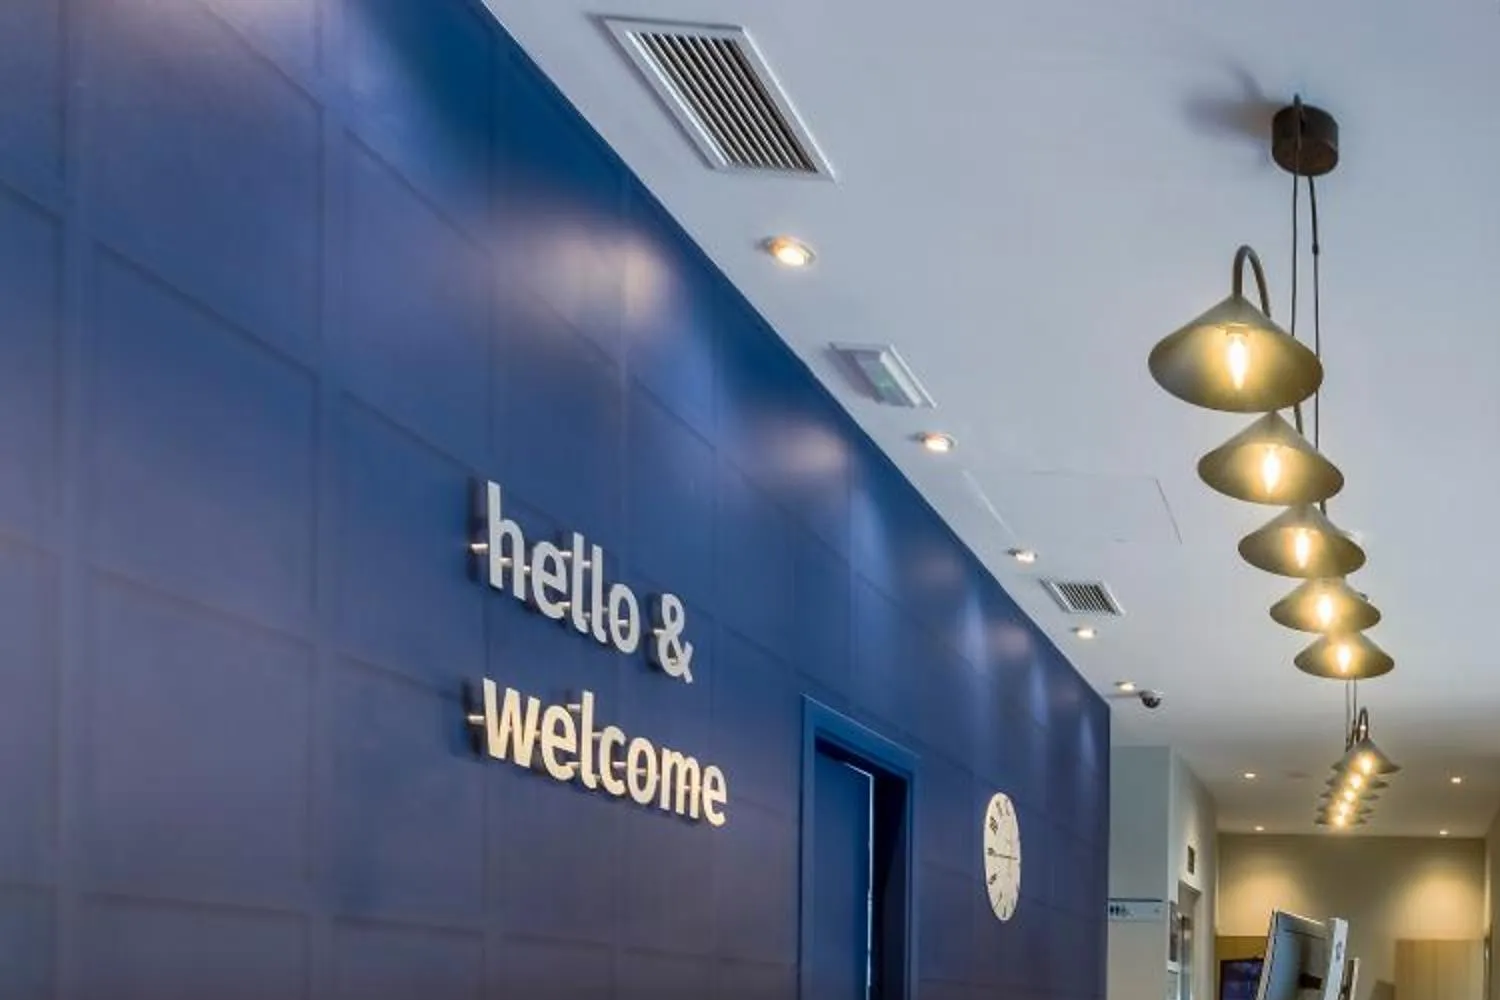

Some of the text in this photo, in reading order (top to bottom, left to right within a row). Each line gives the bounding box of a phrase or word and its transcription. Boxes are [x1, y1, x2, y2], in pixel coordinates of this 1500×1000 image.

[488, 480, 693, 683] hello &
[483, 678, 727, 825] welcome
